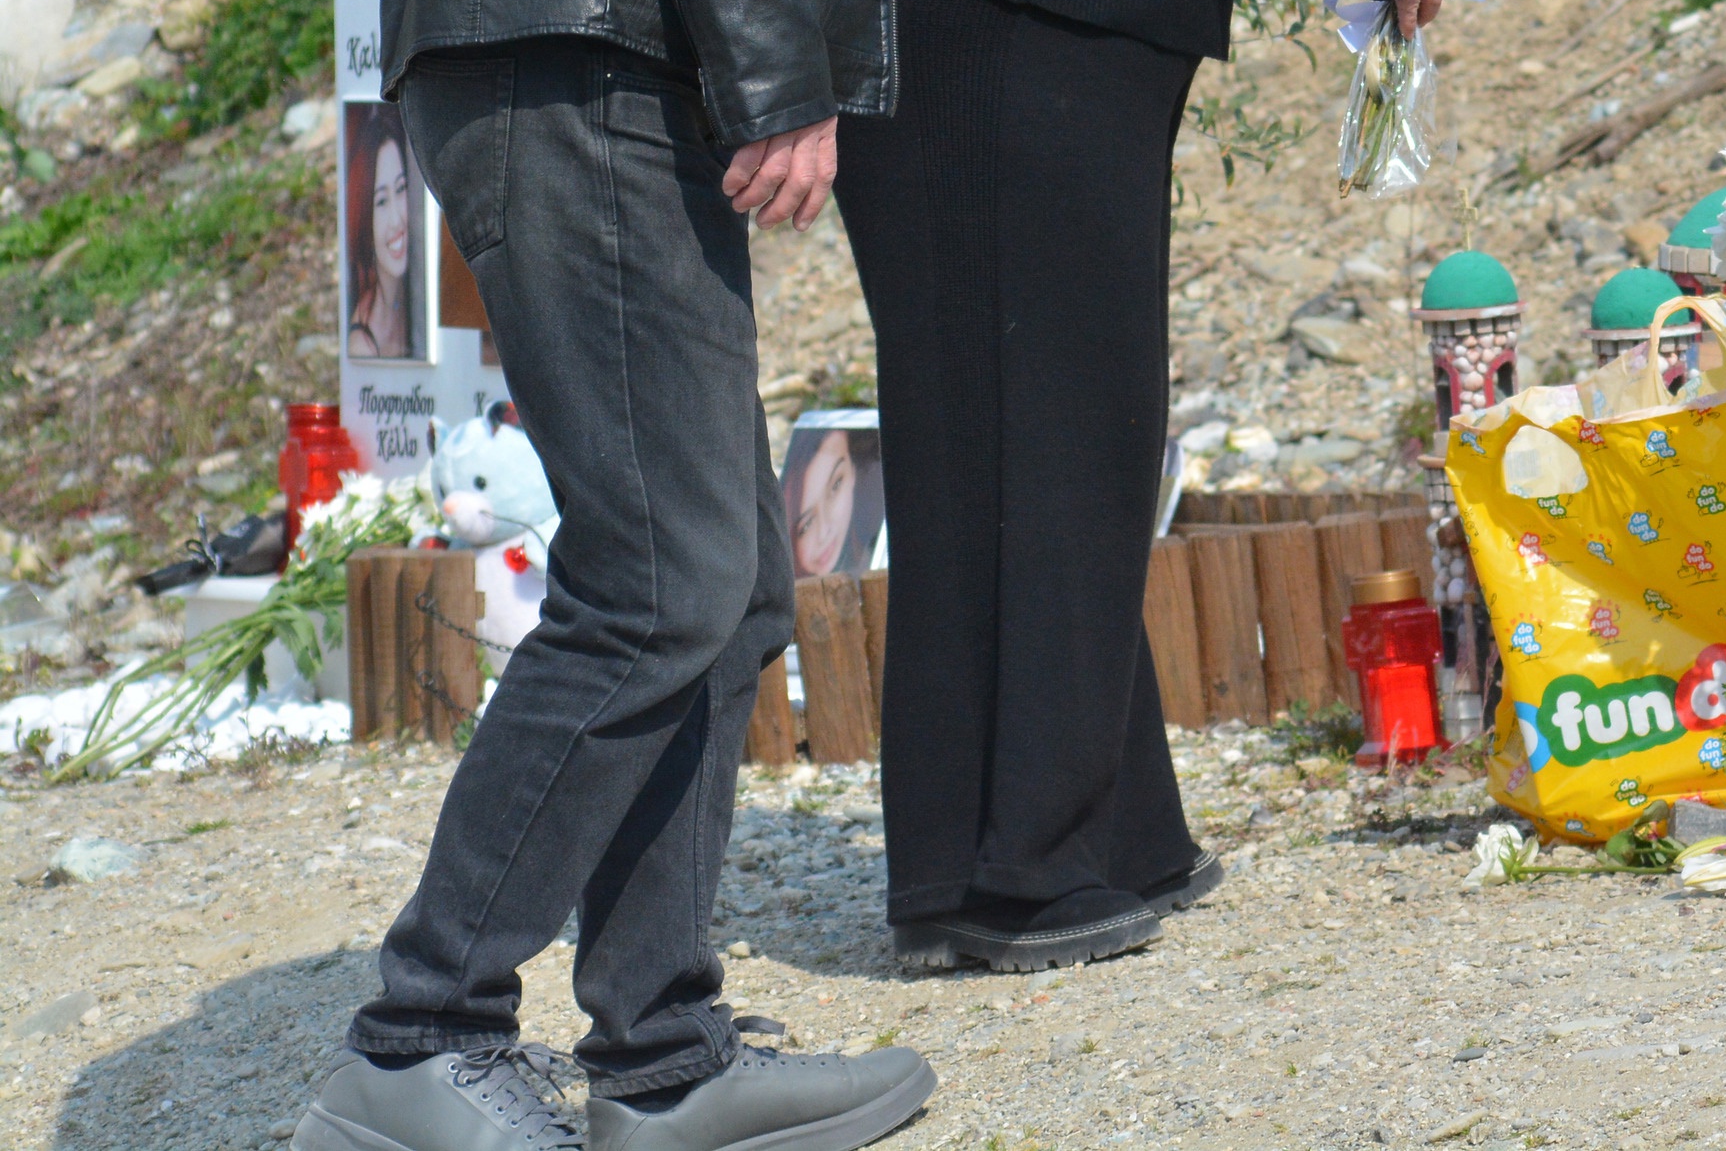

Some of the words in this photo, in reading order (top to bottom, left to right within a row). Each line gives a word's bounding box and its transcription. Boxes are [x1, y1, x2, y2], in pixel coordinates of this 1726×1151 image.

[346, 31, 381, 78] Καλ
[359, 385, 434, 424] Πορφυρίδου
[1650, 432, 1666, 442] do
[376, 427, 418, 462] Κέλλυ
[1660, 448, 1675, 457] do
[1701, 486, 1715, 497] do
[1538, 496, 1558, 508] fun
[1697, 496, 1716, 507] fun
[1549, 506, 1565, 516] do
[1710, 503, 1725, 513] do
[1633, 513, 1648, 524] do
[1629, 523, 1650, 534] fun
[1523, 534, 1538, 545] do
[1641, 530, 1657, 541] do
[1689, 545, 1703, 555] do
[1686, 553, 1705, 564] fun
[1698, 561, 1712, 572] do
[1596, 609, 1610, 619] do
[1518, 623, 1533, 635] do
[1591, 618, 1611, 629] fun
[1602, 626, 1617, 637] do
[1513, 633, 1534, 646] fun
[1524, 642, 1540, 654] do
[1551, 690, 1675, 752] fun
[1704, 739, 1720, 749] do
[1699, 750, 1720, 761] fun
[1620, 780, 1637, 792] do
[1630, 796, 1646, 806] do
